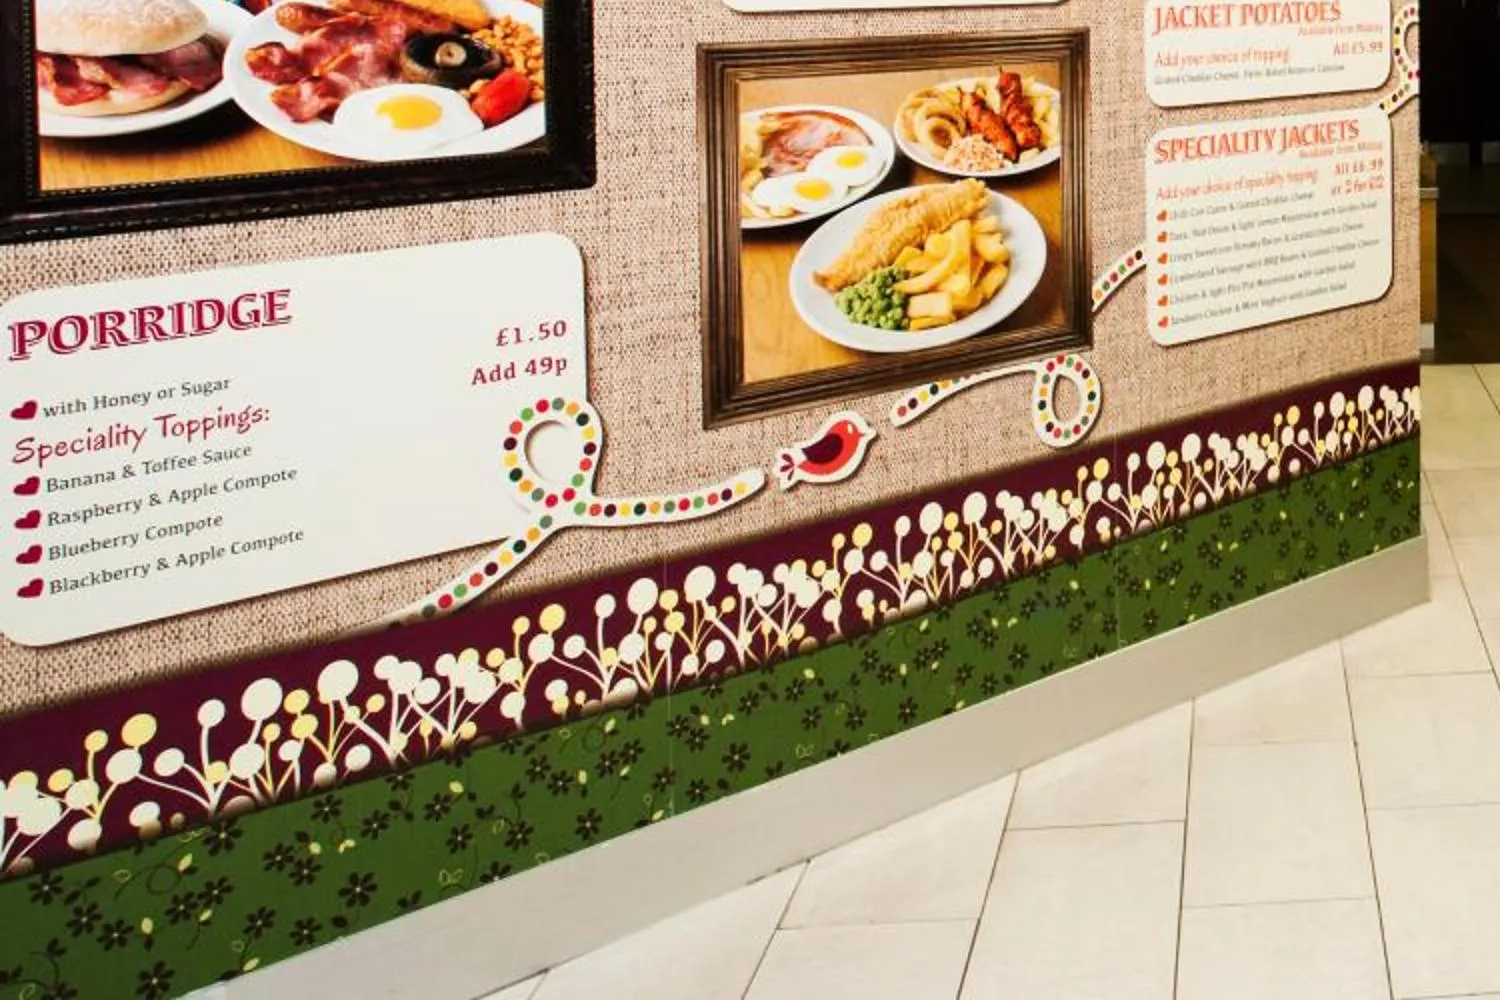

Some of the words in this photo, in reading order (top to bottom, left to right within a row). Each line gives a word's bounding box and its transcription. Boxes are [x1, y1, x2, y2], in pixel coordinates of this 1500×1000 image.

[1152, 3, 1236, 36] JACKET
[1240, 0, 1342, 26] POTATOES
[1155, 128, 1275, 164] SPECIALITY
[1278, 120, 1360, 155] JACKETS
[8, 289, 292, 361] PORRIDGE
[496, 319, 567, 346] £1.50
[472, 361, 516, 385] Add
[525, 357, 567, 376] 49p
[43, 395, 87, 418] with
[93, 391, 152, 411] Honey
[157, 387, 177, 400] or
[181, 378, 230, 398] Sugar
[12, 423, 148, 468] Speciality
[153, 406, 270, 443] Toppings:
[46, 469, 116, 493] Banana
[122, 463, 136, 477] &
[142, 455, 197, 475] Toffee
[202, 445, 252, 465] Sauce
[47, 498, 143, 527] Raspberry
[149, 493, 162, 507] &
[168, 482, 218, 505] Apple
[223, 468, 297, 492] Compote
[48, 532, 139, 561] Blueberry
[145, 514, 223, 541] Compote
[49, 563, 151, 595] Blackberry
[157, 558, 170, 571] &
[175, 545, 225, 568] Apple
[230, 529, 304, 555] Compote
